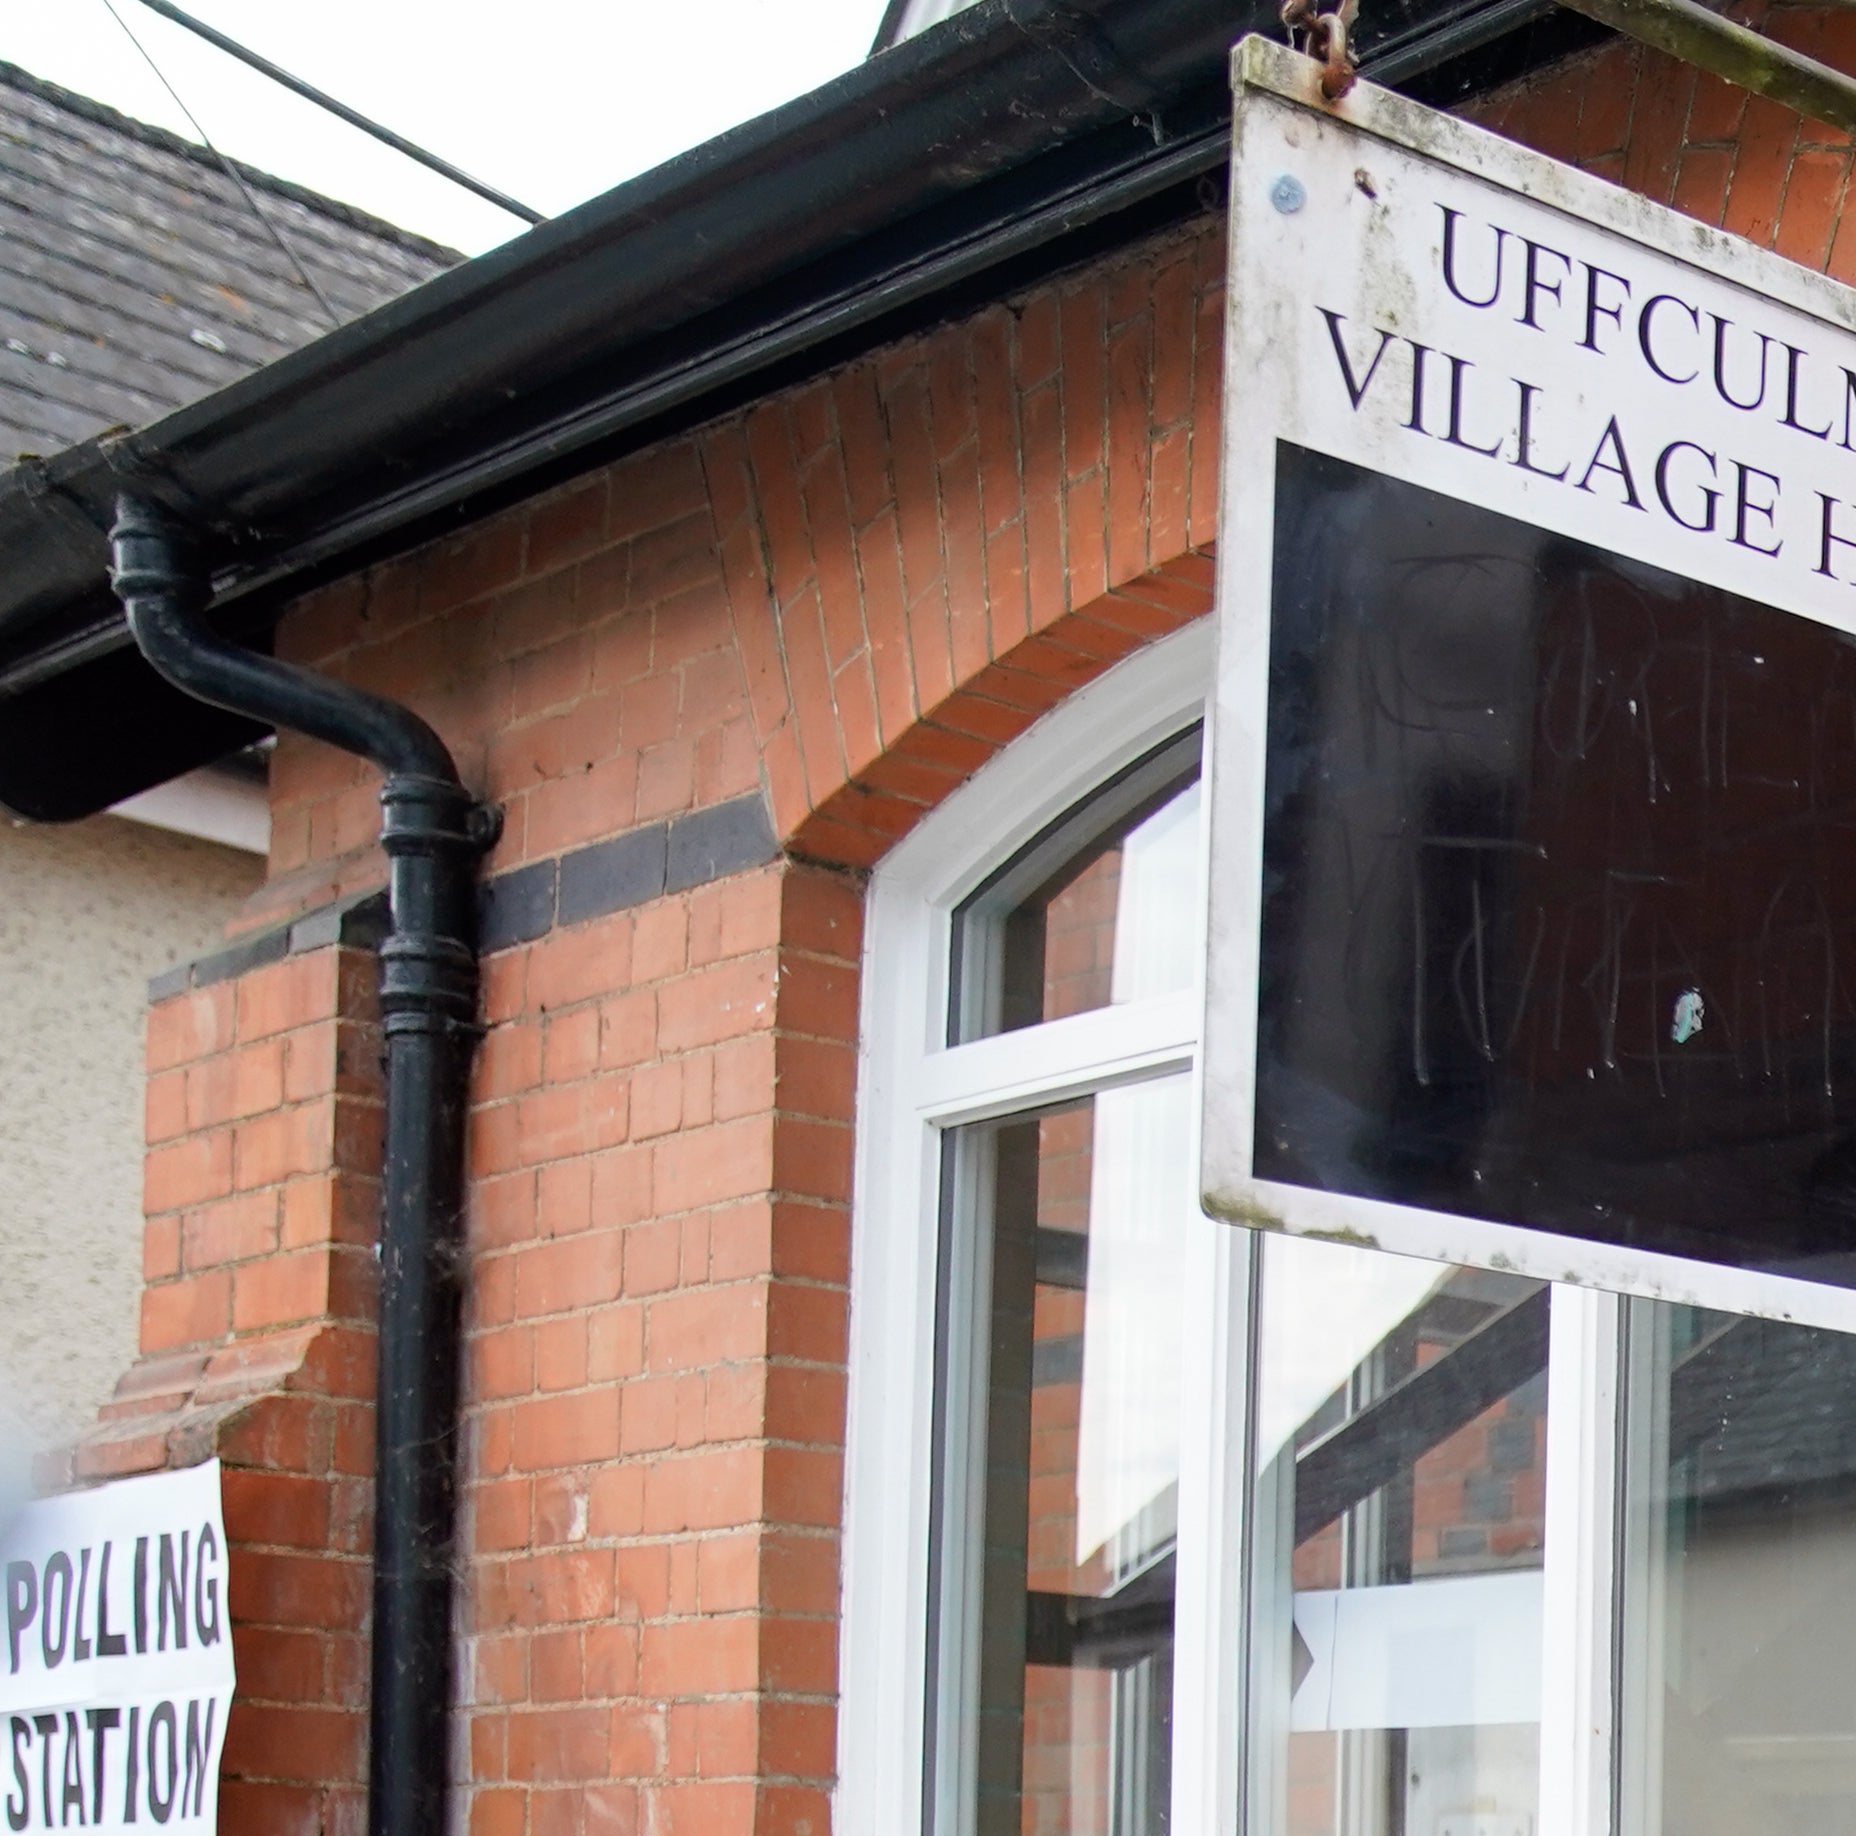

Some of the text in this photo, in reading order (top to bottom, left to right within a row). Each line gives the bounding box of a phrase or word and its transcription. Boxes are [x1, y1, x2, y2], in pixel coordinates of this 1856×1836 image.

[1315, 305, 1783, 558] VILLAGE
[6, 1522, 220, 1675] POLLING
[6, 1697, 217, 1832] STATION
